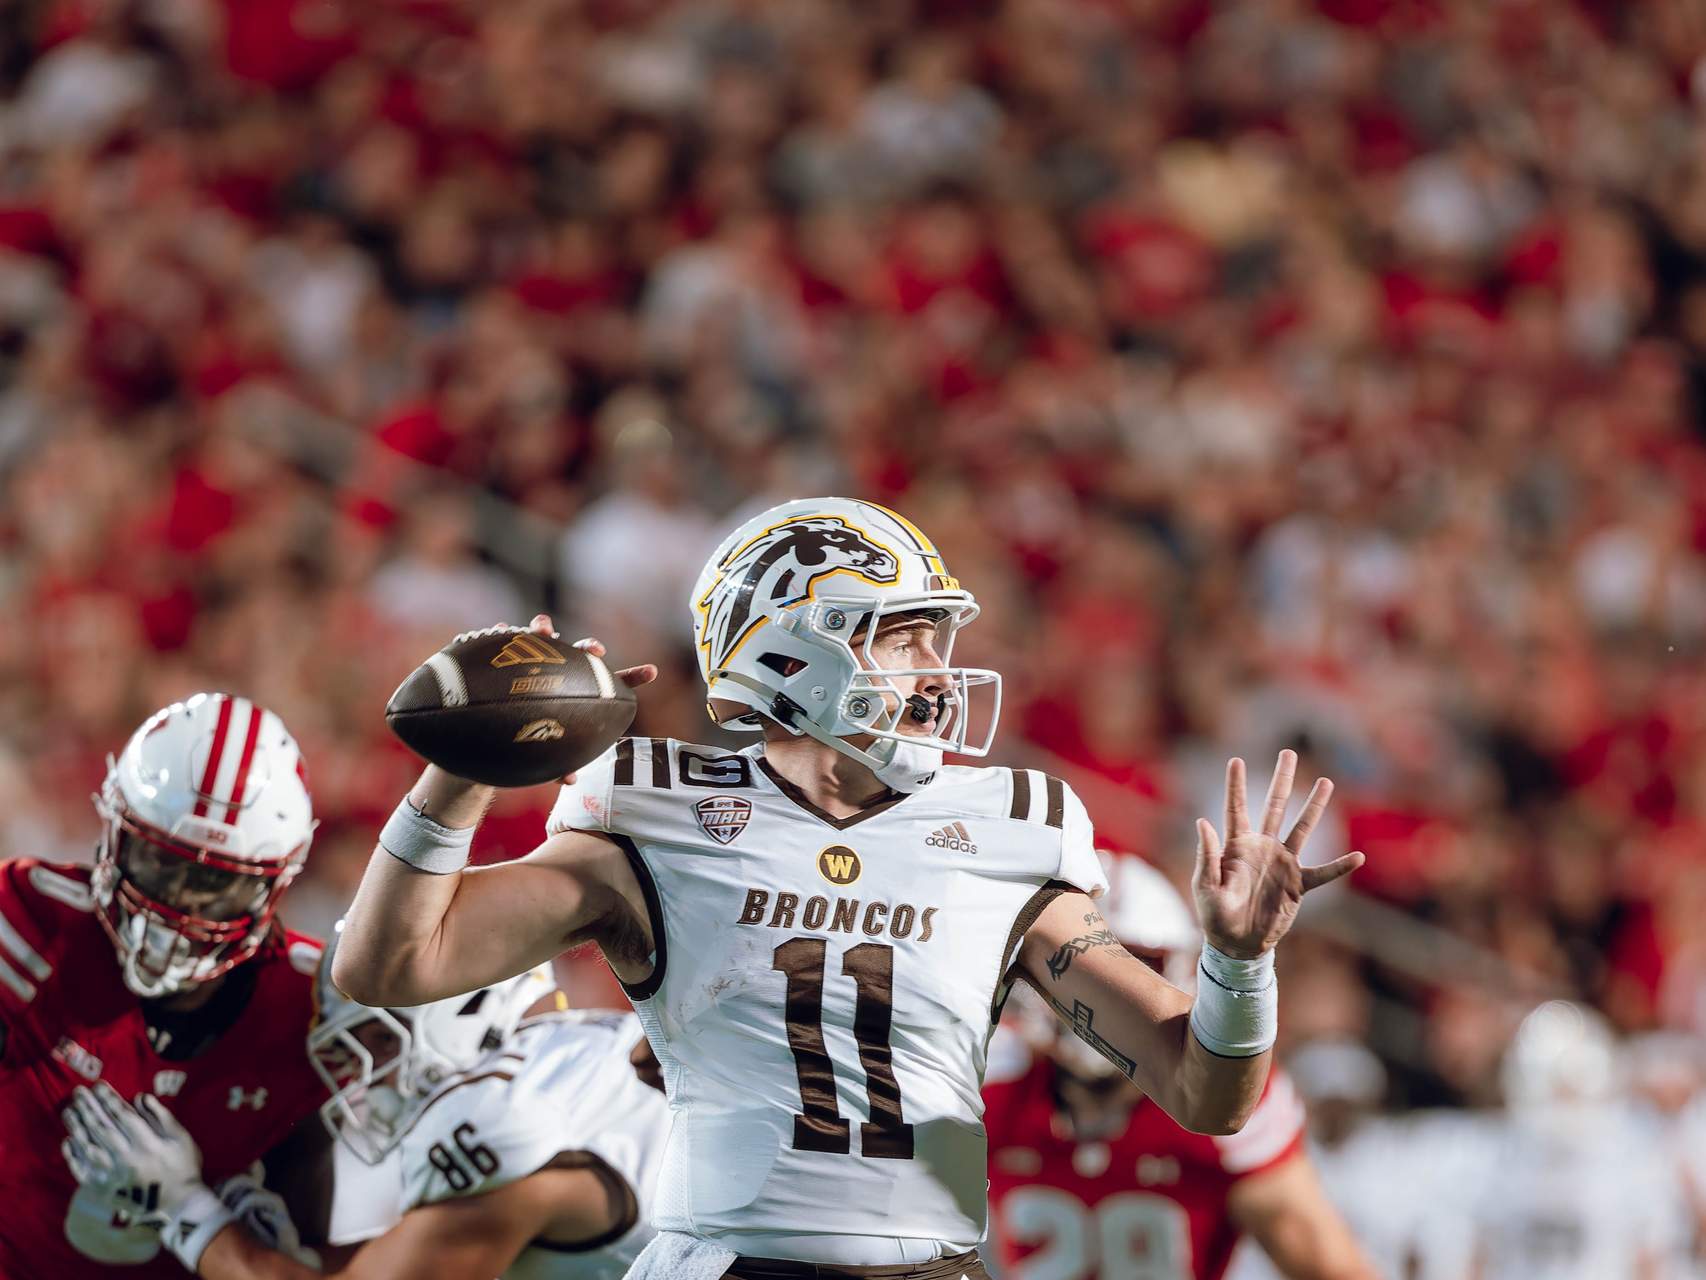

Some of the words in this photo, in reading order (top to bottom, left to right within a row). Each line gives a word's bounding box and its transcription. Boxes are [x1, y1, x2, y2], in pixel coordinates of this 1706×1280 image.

[701, 809, 751, 825] MAC
[925, 836, 978, 855] adidas
[824, 853, 855, 879] W
[736, 888, 939, 943] BRONCOS
[772, 936, 914, 1160] 11
[428, 1122, 499, 1191] 86
